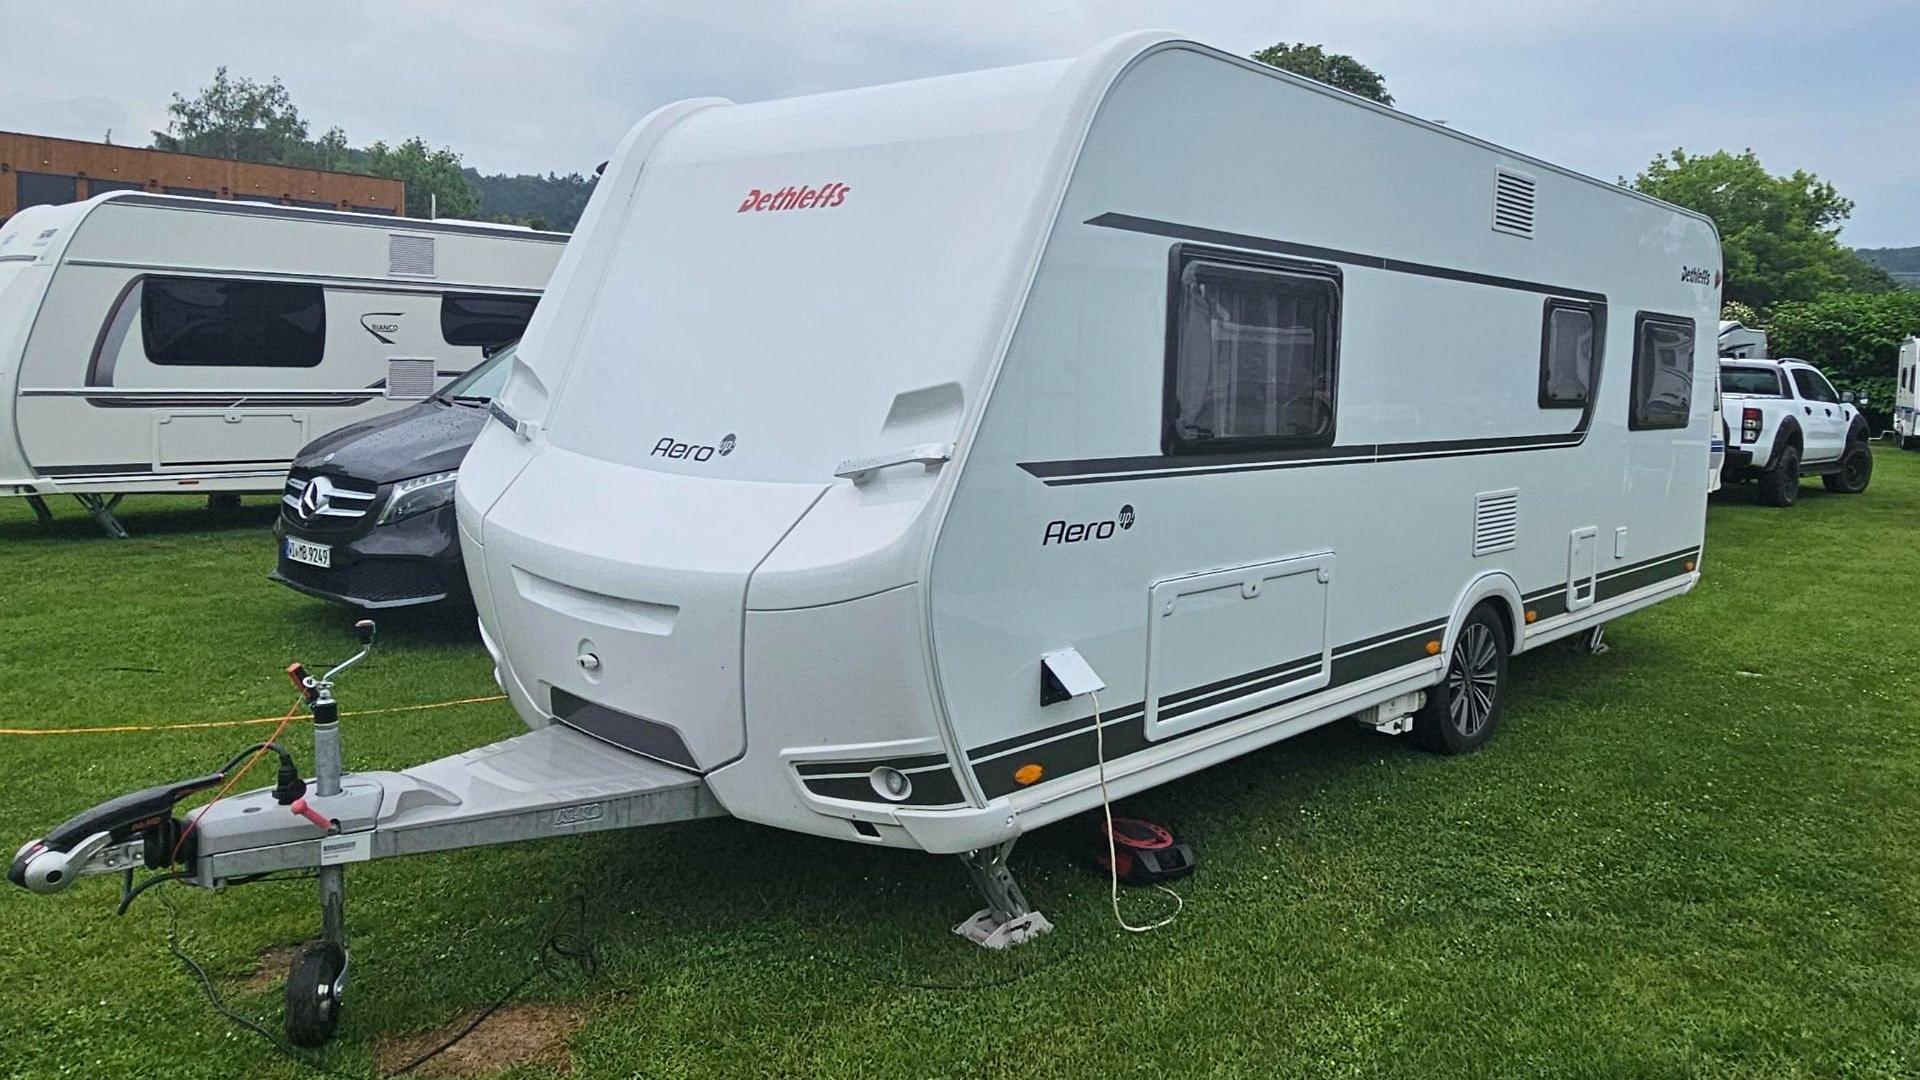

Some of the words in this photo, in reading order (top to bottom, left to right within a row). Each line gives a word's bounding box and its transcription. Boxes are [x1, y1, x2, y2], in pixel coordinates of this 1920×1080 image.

[737, 183, 851, 213] Dethleffs
[1681, 266, 1710, 285] Dethleffs
[371, 323, 399, 331] BIANCO
[650, 437, 715, 462] Aero
[1042, 520, 1115, 546] Aero
[309, 546, 328, 565] 9249
